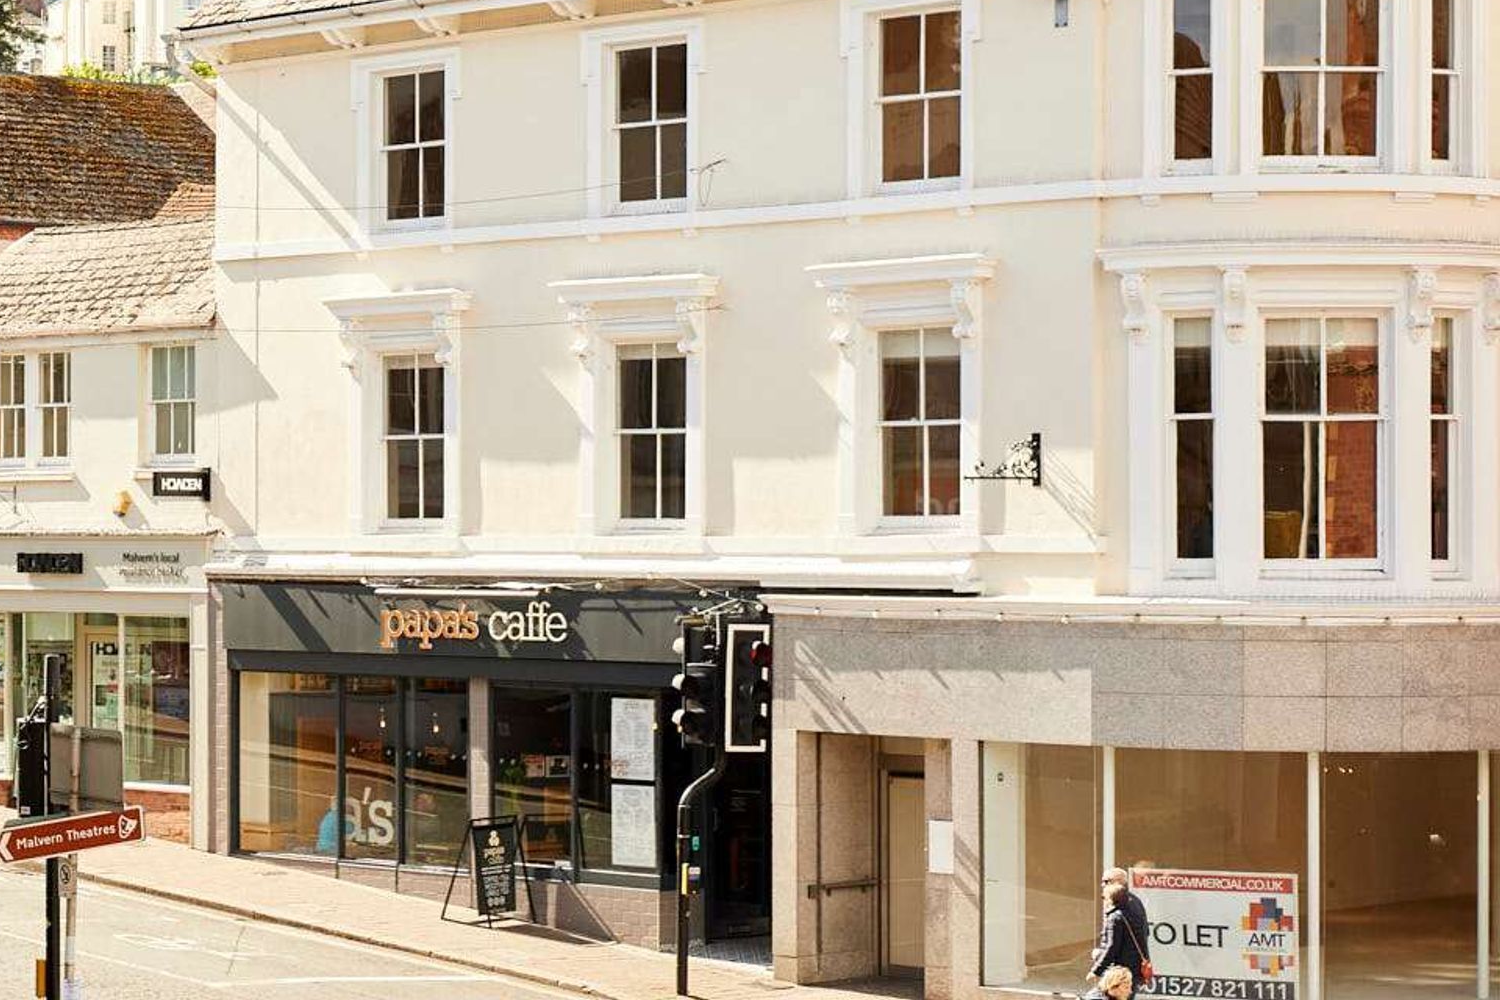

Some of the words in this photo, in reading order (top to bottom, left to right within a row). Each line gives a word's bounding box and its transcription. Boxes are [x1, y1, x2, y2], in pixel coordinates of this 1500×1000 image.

[161, 477, 203, 491] HOWDEN
[379, 599, 480, 650] papa's
[488, 601, 568, 642] caffe
[16, 833, 64, 850] Malvern
[66, 824, 116, 840] Theatres
[1182, 924, 1229, 948] LET
[1248, 932, 1286, 947] AMT
[1211, 979, 1247, 998] 821
[1254, 981, 1287, 1000] 111
